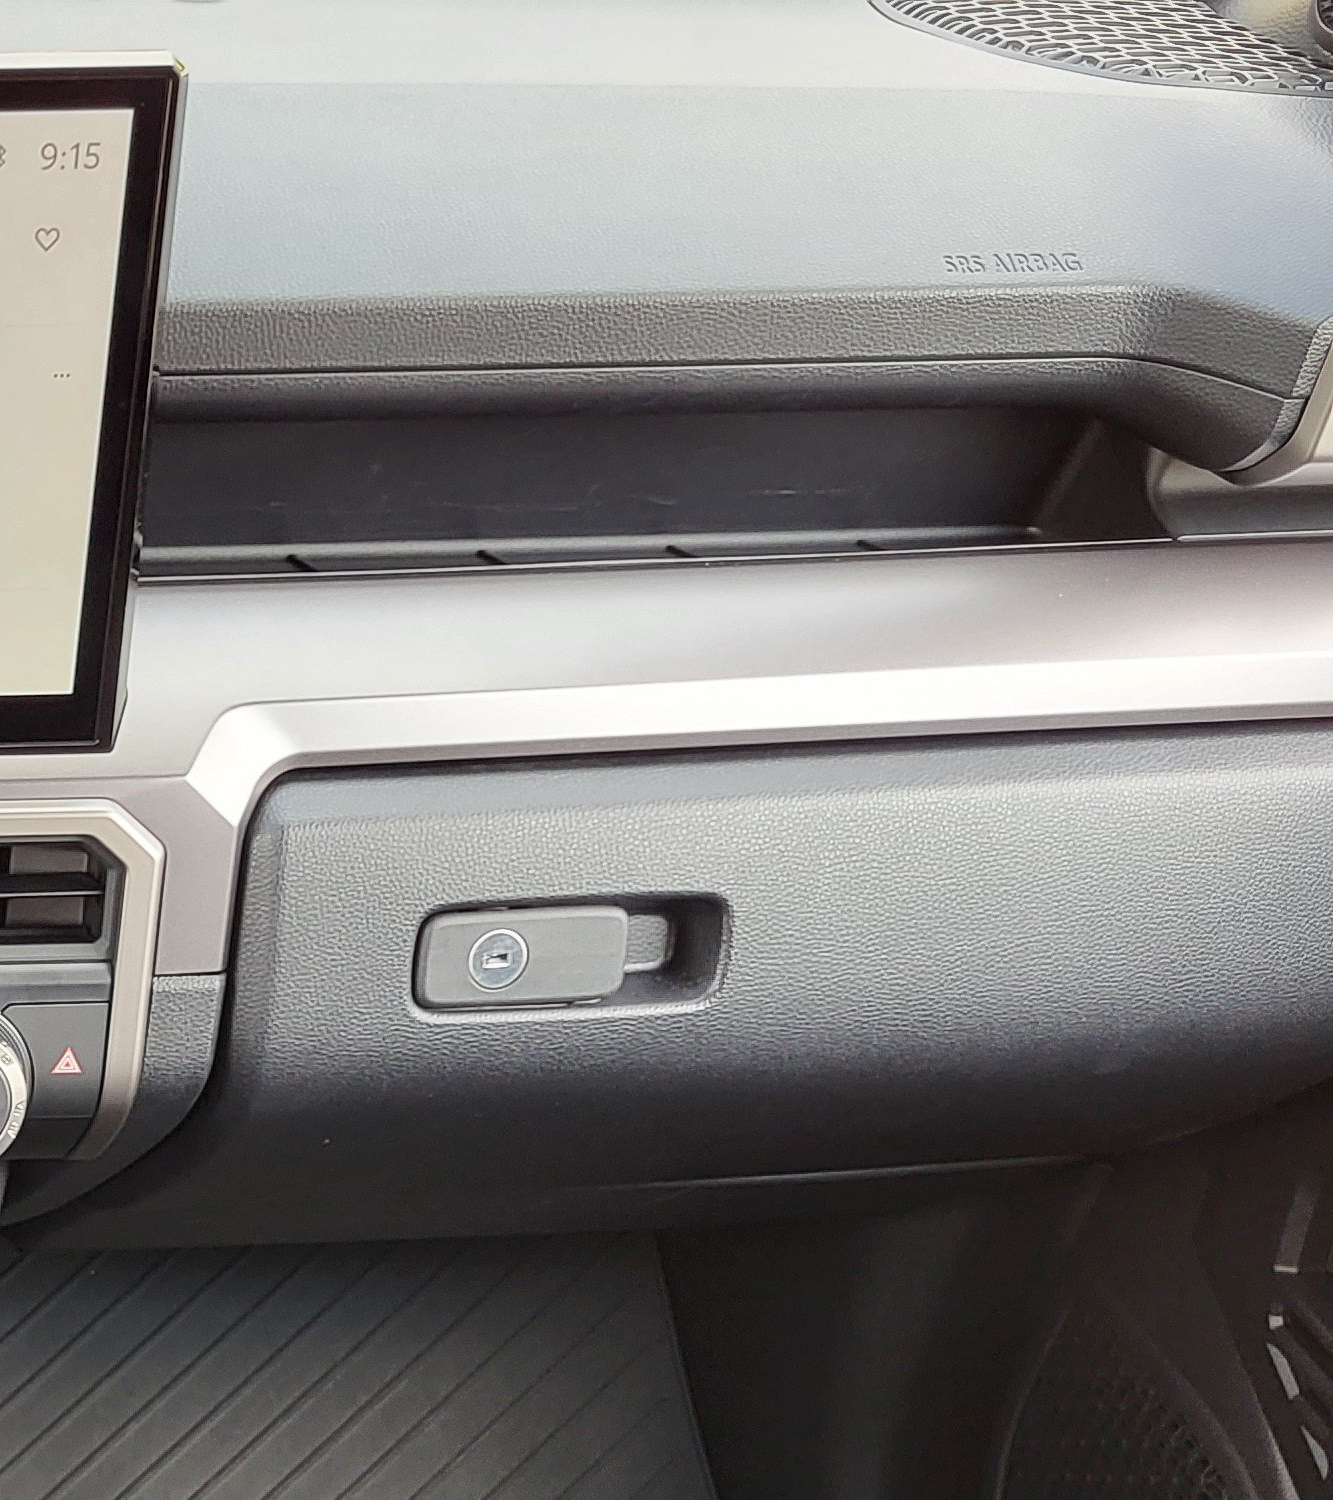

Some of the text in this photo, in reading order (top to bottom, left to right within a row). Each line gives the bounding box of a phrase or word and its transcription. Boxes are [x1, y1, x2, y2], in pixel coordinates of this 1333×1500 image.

[41, 142, 101, 170] 9:15
[942, 252, 1085, 274] SRS AIRBAG
